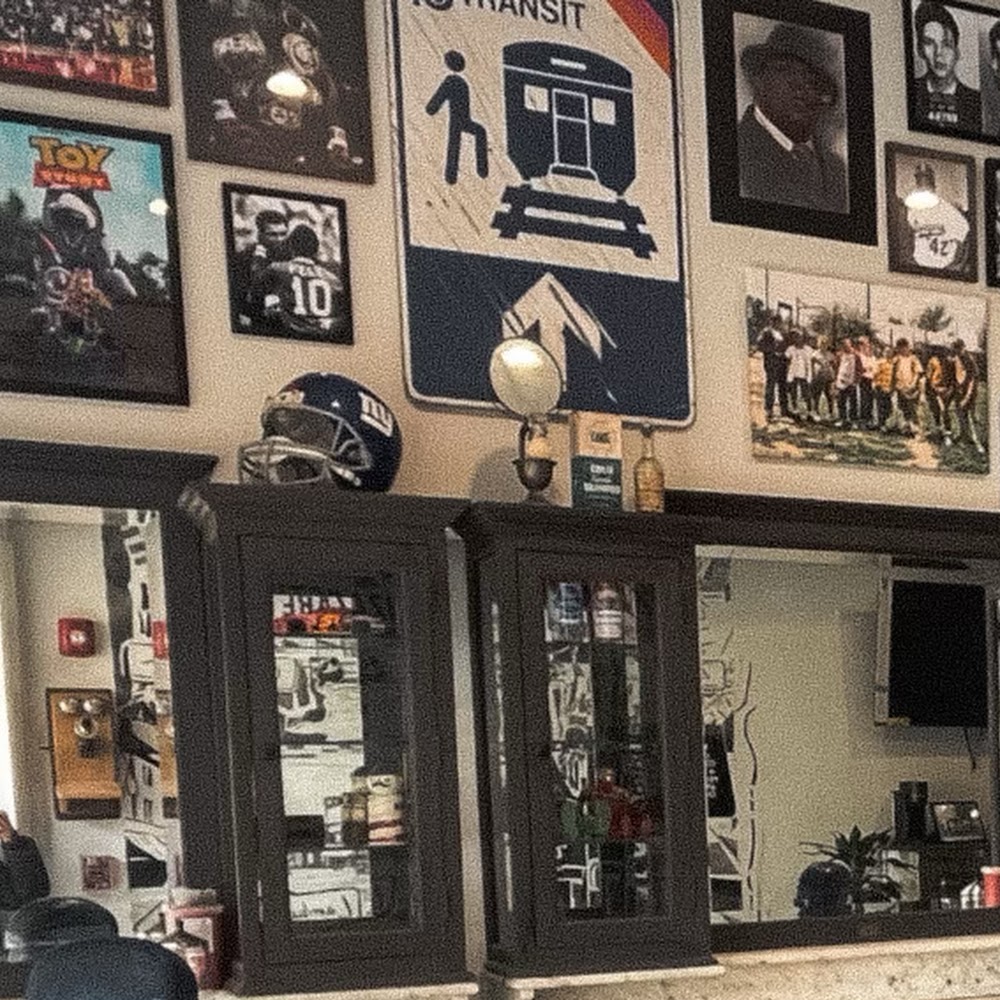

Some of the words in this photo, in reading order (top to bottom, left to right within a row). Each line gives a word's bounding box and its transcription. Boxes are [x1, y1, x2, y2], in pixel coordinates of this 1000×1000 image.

[463, 0, 586, 31] ANSIT
[28, 135, 114, 171] TOY
[291, 275, 332, 317] 10
